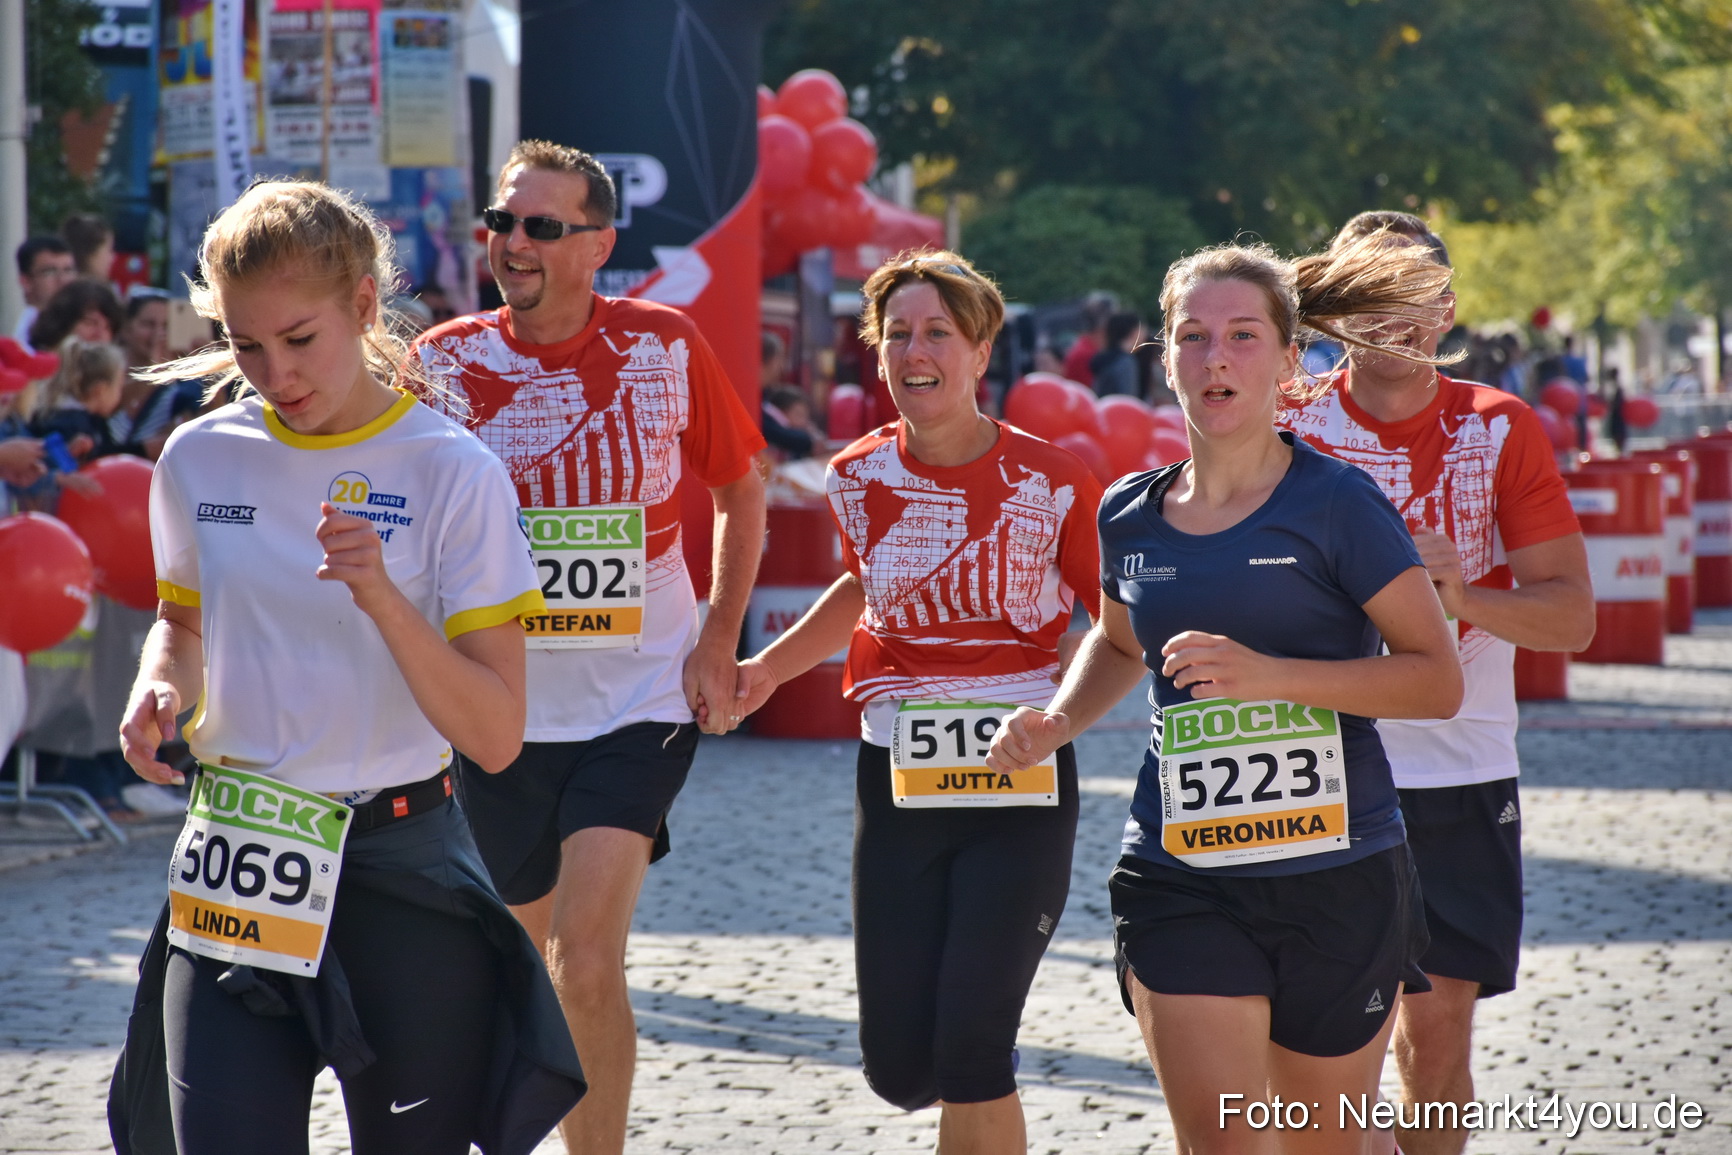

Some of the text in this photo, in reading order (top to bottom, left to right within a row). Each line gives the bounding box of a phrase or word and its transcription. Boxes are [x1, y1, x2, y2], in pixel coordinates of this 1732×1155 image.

[507, 418, 548, 429] 52.01
[506, 436, 549, 447] 26.22
[1343, 437, 1379, 451] 10.54
[901, 476, 933, 490] 10.54
[332, 479, 403, 507] 20 JAHRE
[198, 502, 257, 521] BOCK
[895, 536, 930, 549] 52.01
[892, 556, 929, 568] 26.22
[525, 614, 611, 632] STEFAN
[1173, 701, 1324, 749] BOCK
[1326, 750, 1334, 758] S
[936, 772, 1014, 790] JUTTA
[1179, 748, 1321, 811] 5223
[198, 771, 331, 844] BOCK
[1181, 814, 1327, 849] VERONIKA
[181, 829, 312, 906] 5069
[320, 863, 329, 873] S
[192, 906, 261, 943] LINDA
